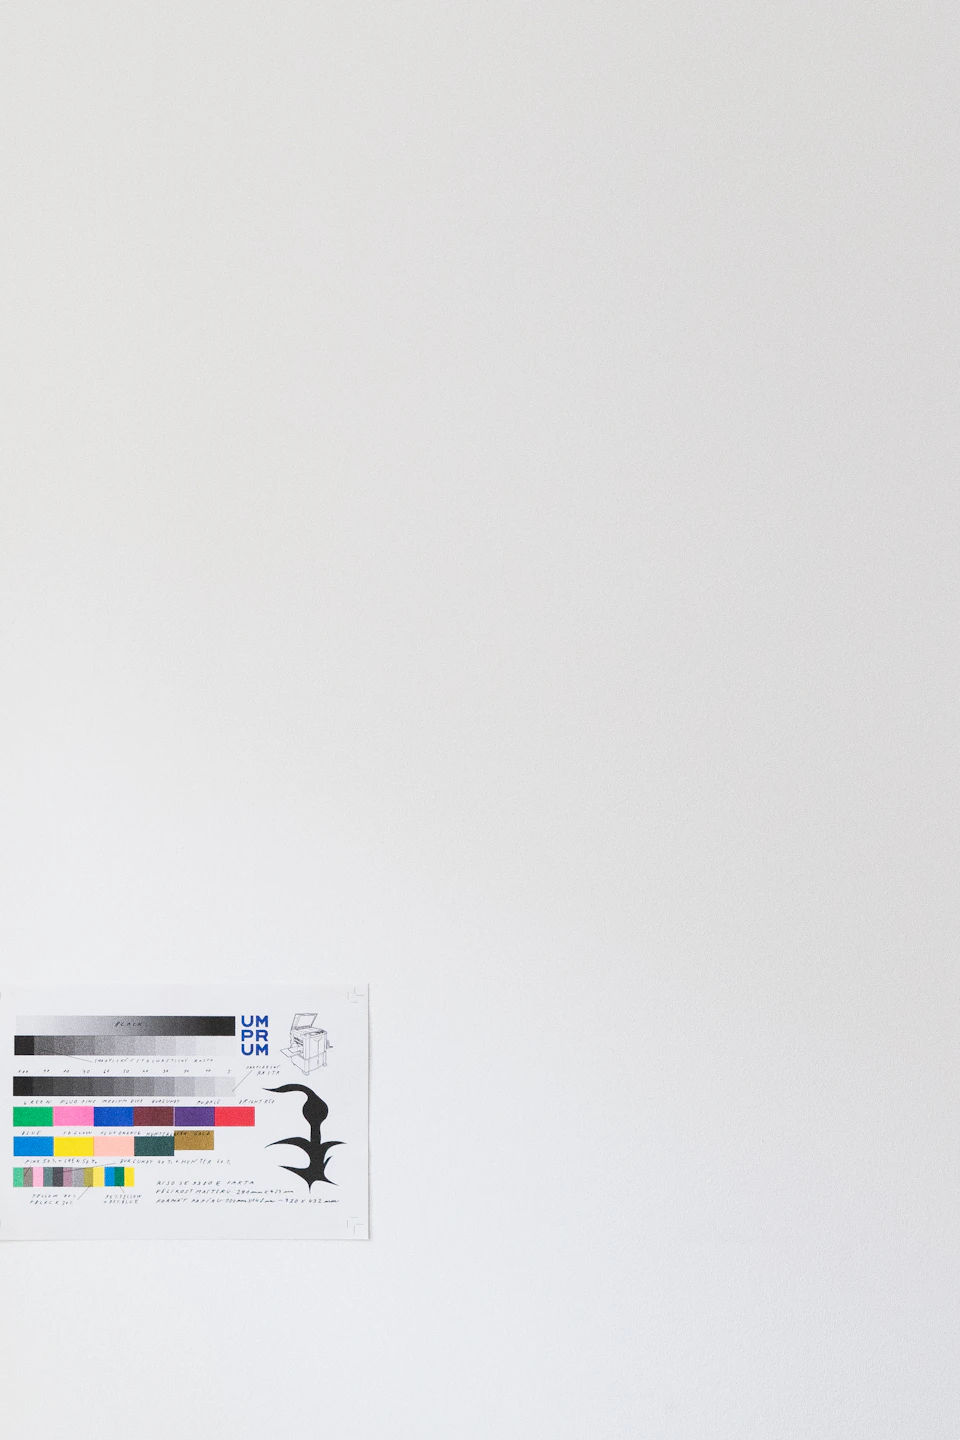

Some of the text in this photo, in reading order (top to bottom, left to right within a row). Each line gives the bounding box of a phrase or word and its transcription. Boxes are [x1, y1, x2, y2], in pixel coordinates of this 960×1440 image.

[241, 1015, 269, 1028] UM
[241, 1029, 269, 1042] PR
[241, 1043, 269, 1056] UM
